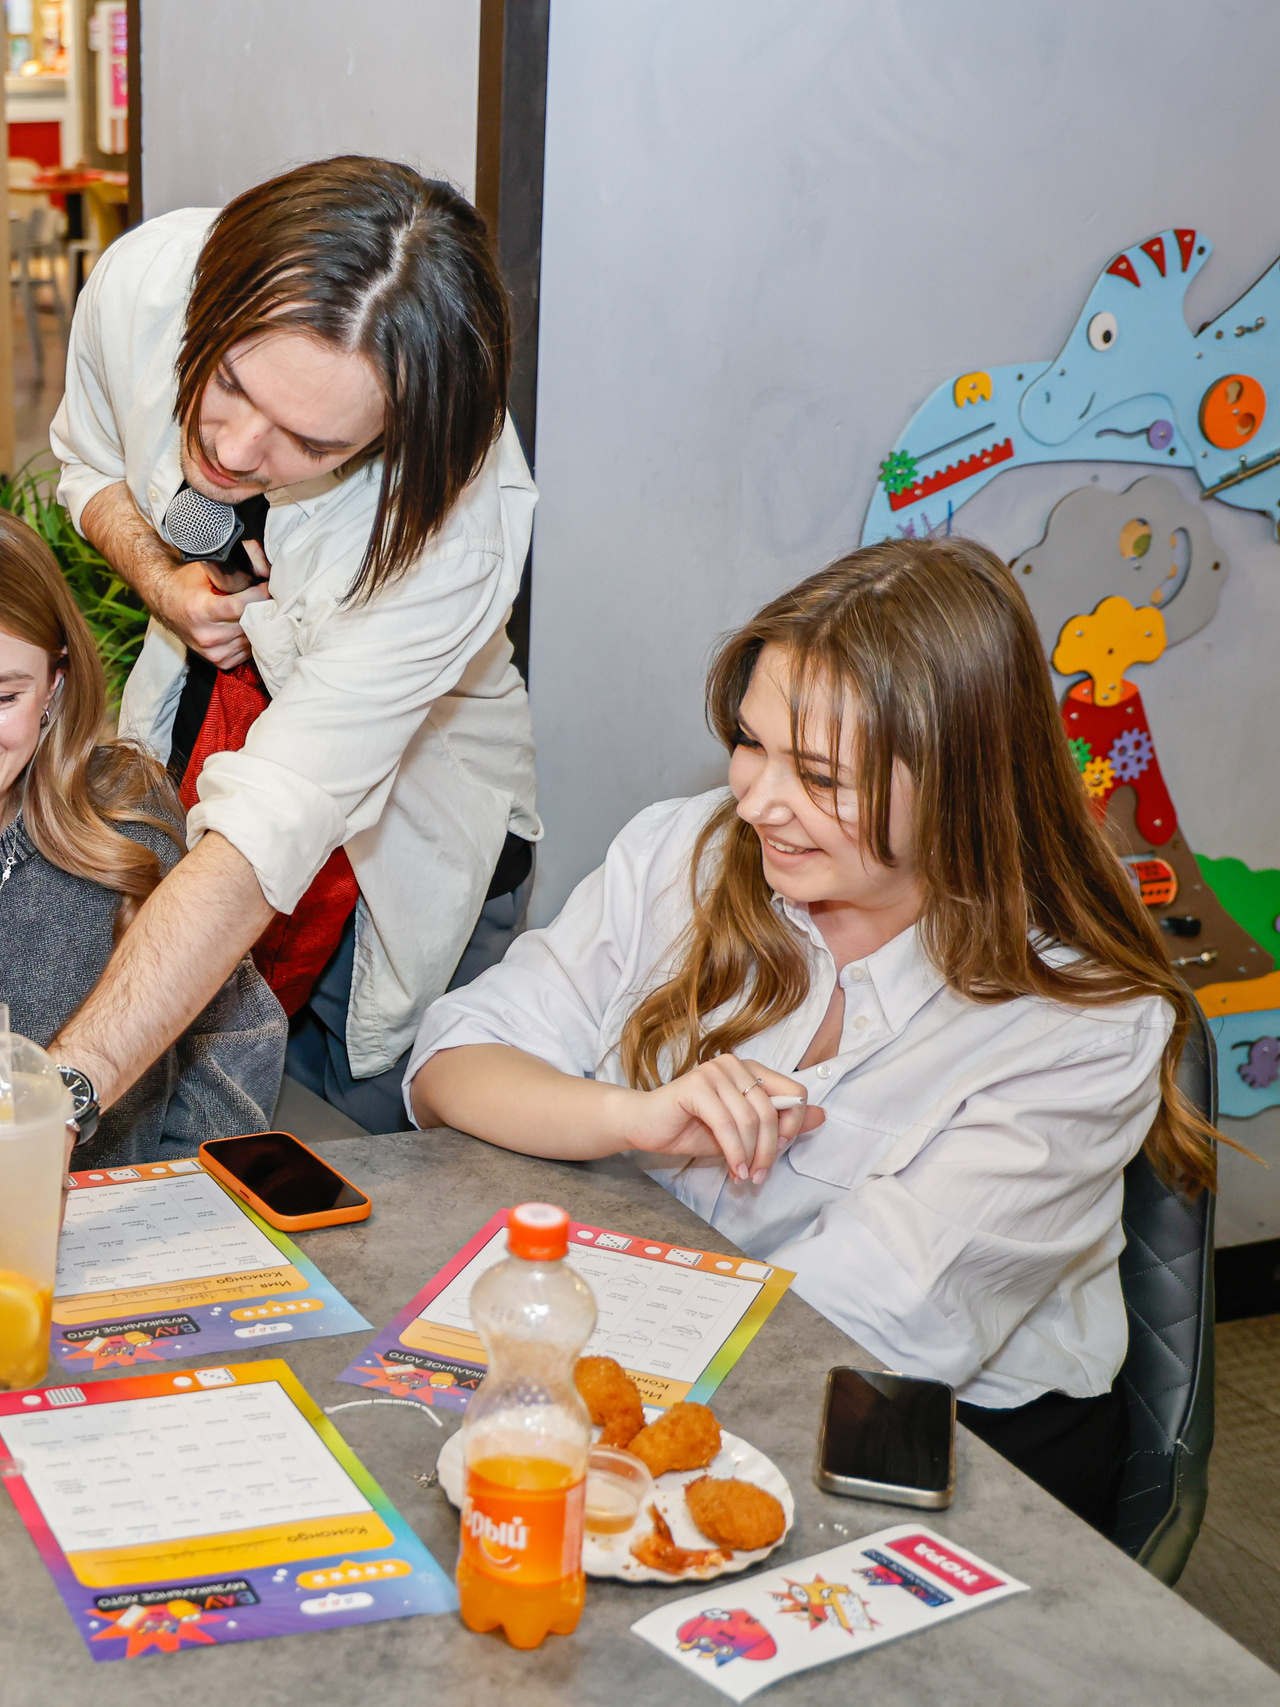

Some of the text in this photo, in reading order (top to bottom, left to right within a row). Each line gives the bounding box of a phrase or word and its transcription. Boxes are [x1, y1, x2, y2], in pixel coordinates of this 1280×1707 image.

[216, 1270, 284, 1285] Команда
[66, 1315, 189, 1339] МУЗЫКАЛЬНОЕ ЛОТО
[154, 1322, 197, 1338] ВАУ
[388, 1351, 424, 1365] ЛОТО
[637, 1388, 663, 1400] Им
